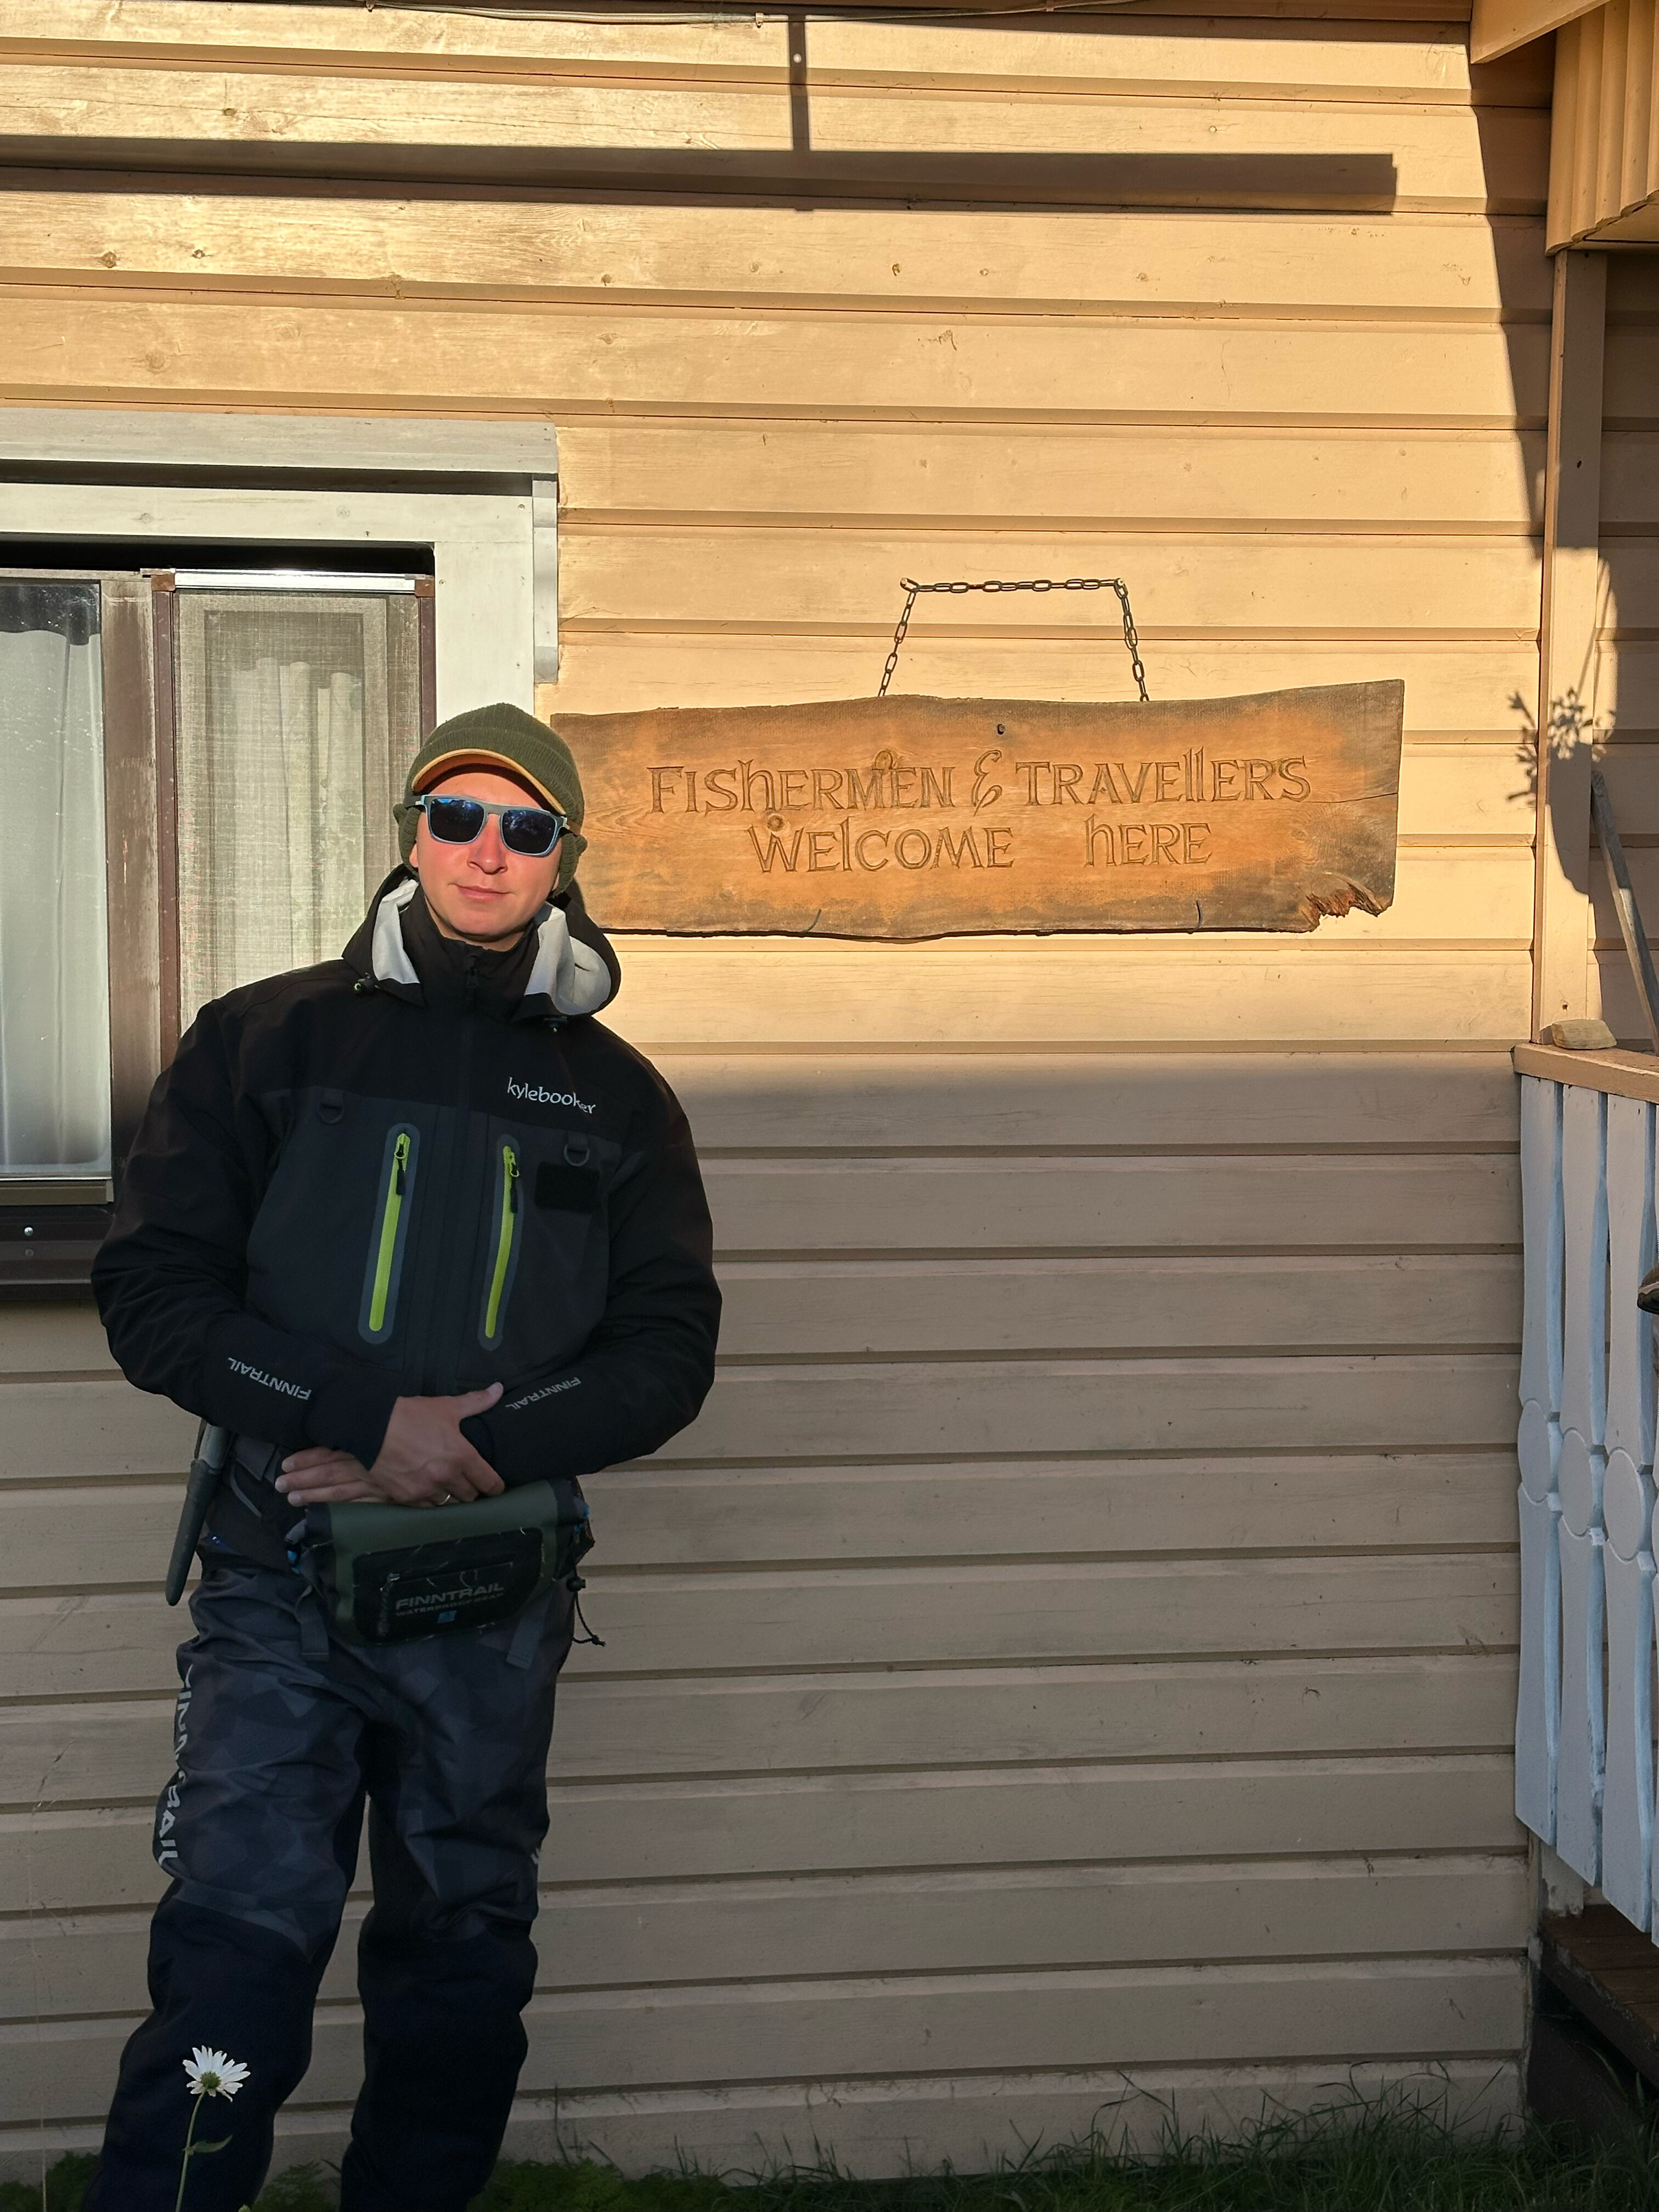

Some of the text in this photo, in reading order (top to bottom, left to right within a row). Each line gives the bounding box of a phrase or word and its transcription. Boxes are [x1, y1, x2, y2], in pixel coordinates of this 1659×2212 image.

[973, 749, 1003, 816] &
[507, 1076, 596, 1114] kylebooker
[228, 1357, 312, 1400] FINNTRAIL
[505, 1376, 582, 1410] FINNTRAIL
[395, 1583, 505, 1610] FINNTRAIL
